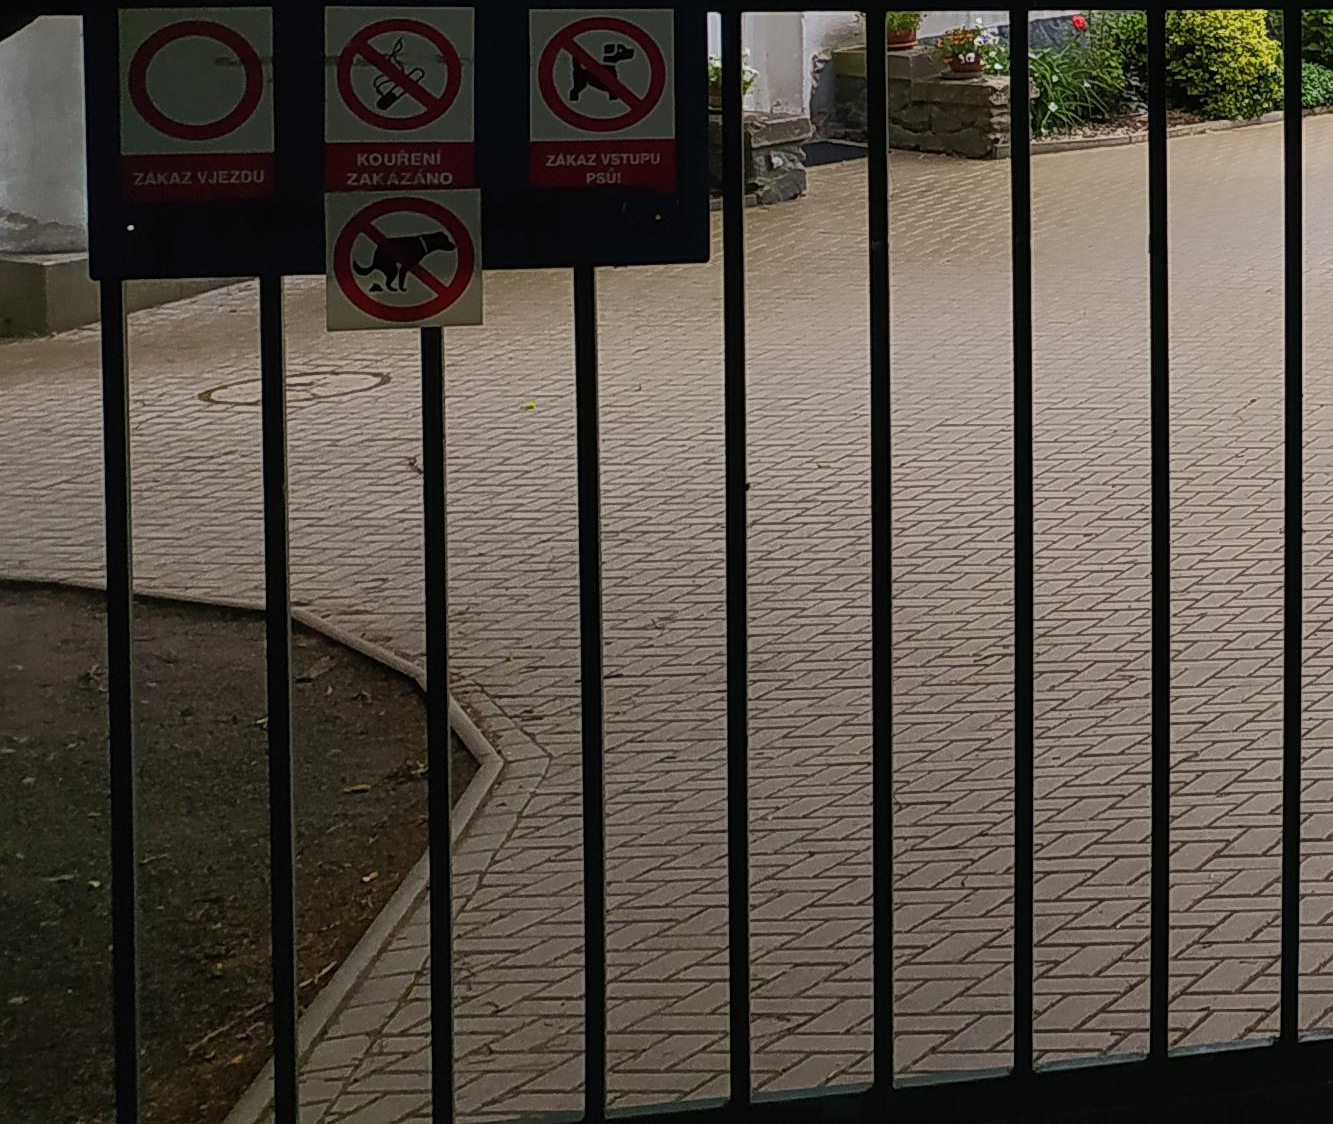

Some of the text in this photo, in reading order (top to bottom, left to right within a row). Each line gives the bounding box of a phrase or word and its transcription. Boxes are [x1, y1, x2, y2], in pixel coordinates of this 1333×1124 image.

[356, 149, 442, 167] KOUŘENÍ
[600, 152, 661, 166] VSTUPU
[196, 168, 265, 185] VJEZDU
